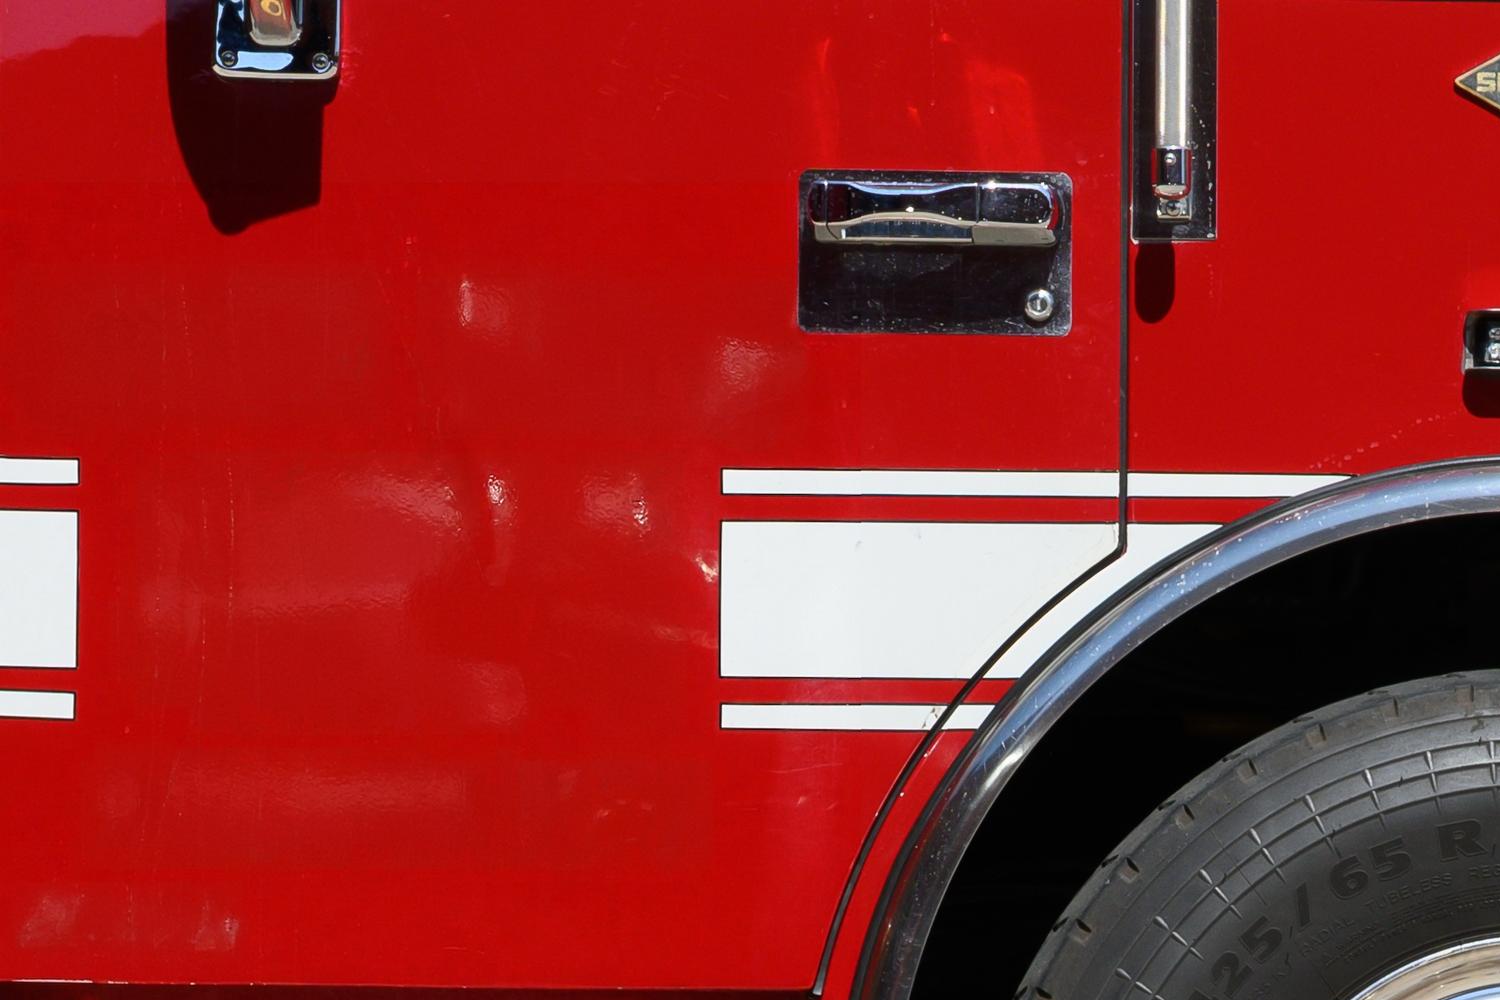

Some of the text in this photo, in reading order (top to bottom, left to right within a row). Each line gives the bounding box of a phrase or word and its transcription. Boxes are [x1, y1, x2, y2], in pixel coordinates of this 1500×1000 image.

[1433, 817, 1489, 862] R
[1295, 911, 1356, 959] RADIAL
[1362, 870, 1453, 916] TUBELESS
